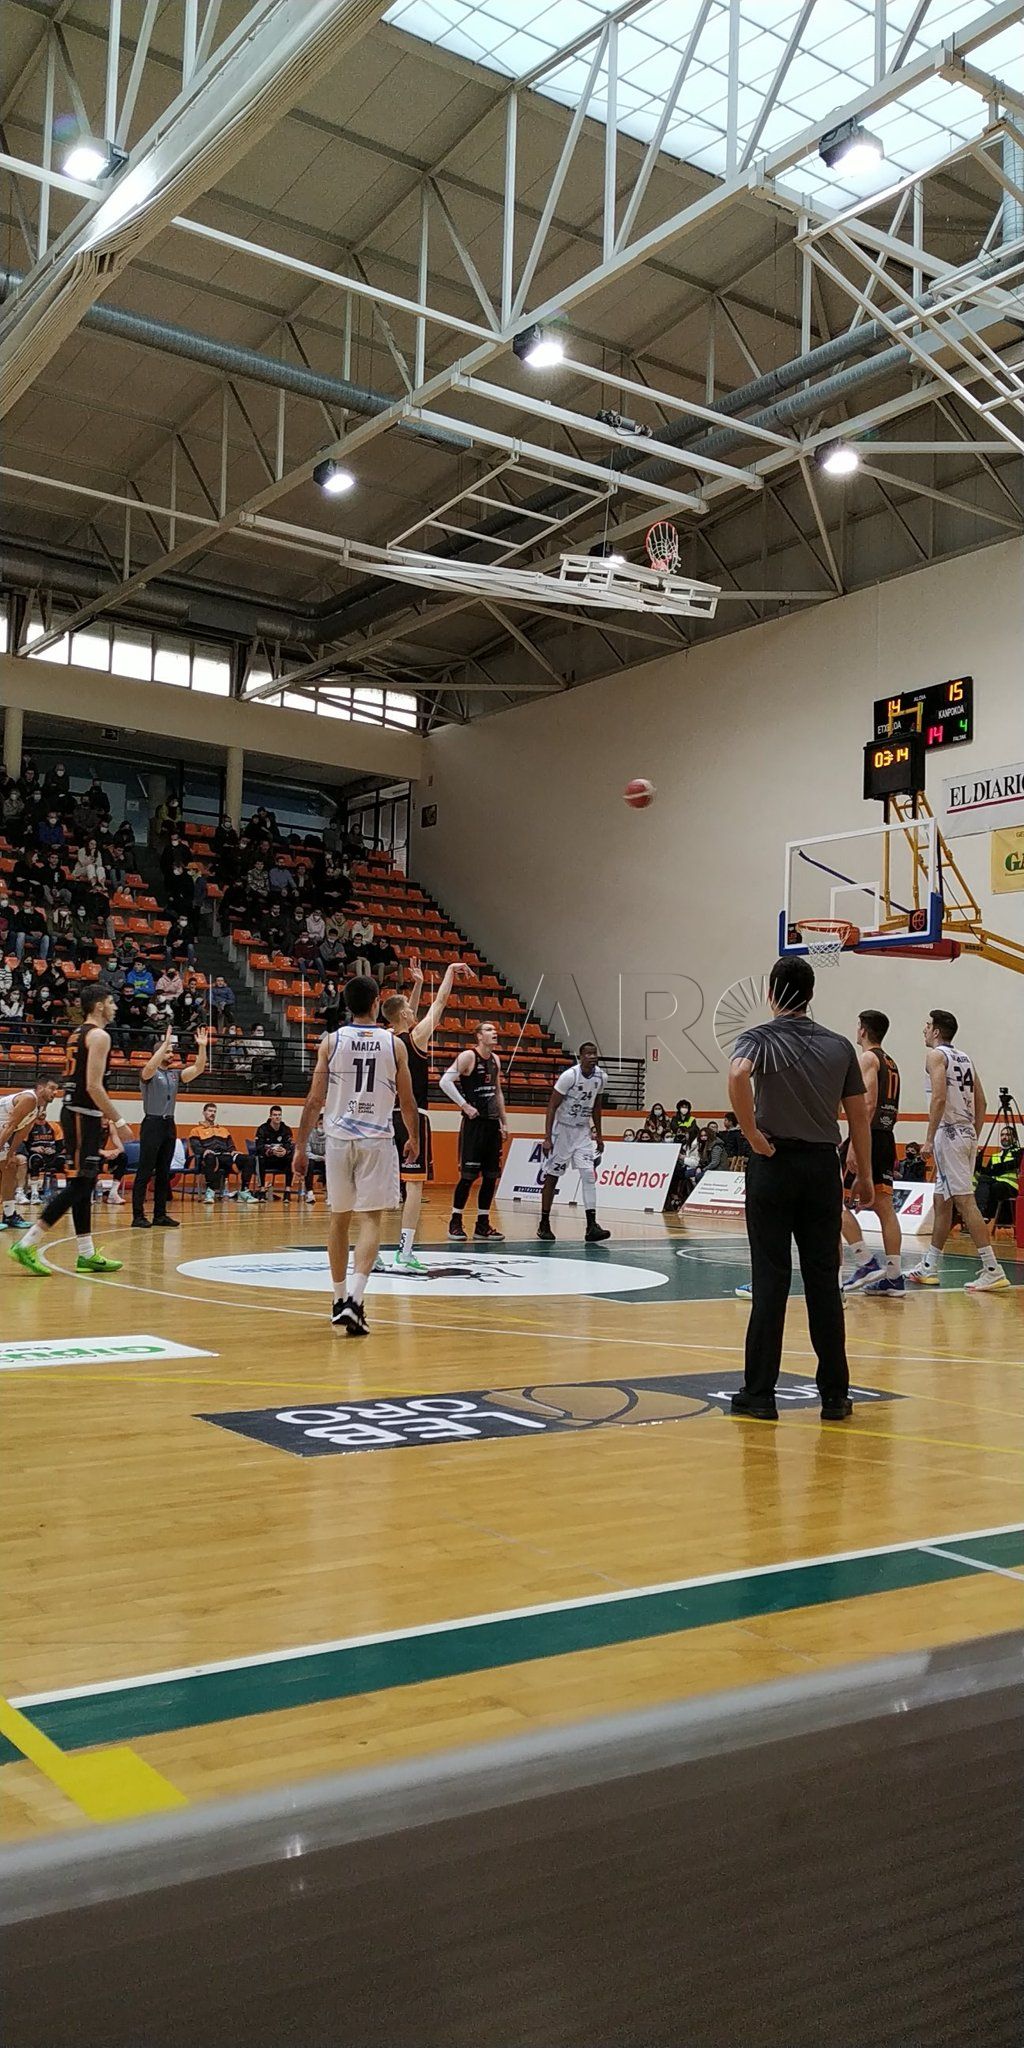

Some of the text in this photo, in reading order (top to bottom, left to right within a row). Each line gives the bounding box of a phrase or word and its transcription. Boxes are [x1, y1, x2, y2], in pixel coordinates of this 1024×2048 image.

[949, 681, 963, 701] 15
[889, 699, 900, 716] 14
[938, 705, 965, 719] KANPOKOA
[928, 725, 943, 744] 14
[960, 719, 967, 732] 4
[950, 773, 1024, 807] EL DIARI
[351, 1040, 381, 1051] MAIZA
[352, 1058, 377, 1093] 11
[953, 1066, 974, 1093] 34
[580, 1091, 593, 1101] 24
[553, 1162, 567, 1172] 24
[598, 1163, 669, 1189] sidenor
[275, 1399, 478, 1425] ORO
[304, 1411, 546, 1445] LEB
